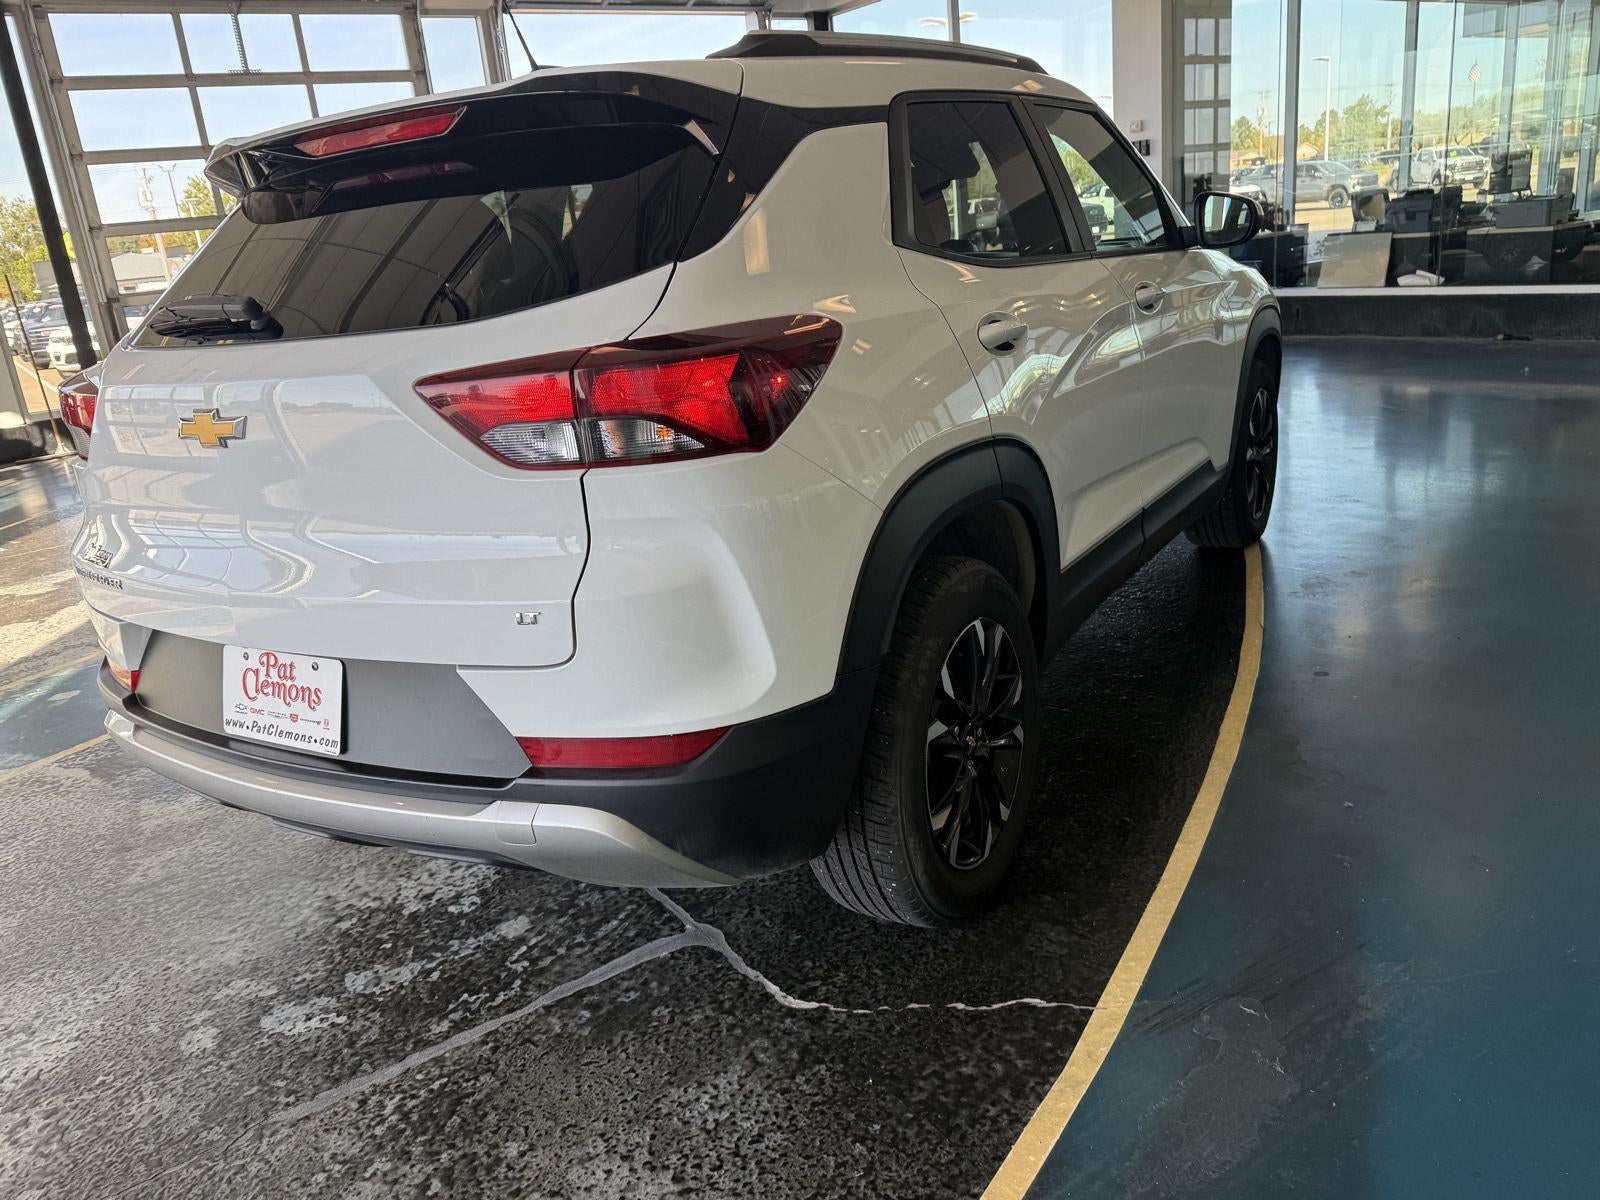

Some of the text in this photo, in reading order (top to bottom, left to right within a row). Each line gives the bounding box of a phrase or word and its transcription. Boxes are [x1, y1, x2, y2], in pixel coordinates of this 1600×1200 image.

[515, 611, 541, 625] LT
[259, 651, 296, 681] Pat
[242, 667, 322, 711] Clemons
[249, 707, 265, 716] GMC
[225, 718, 339, 749] www.PatClemons.com
